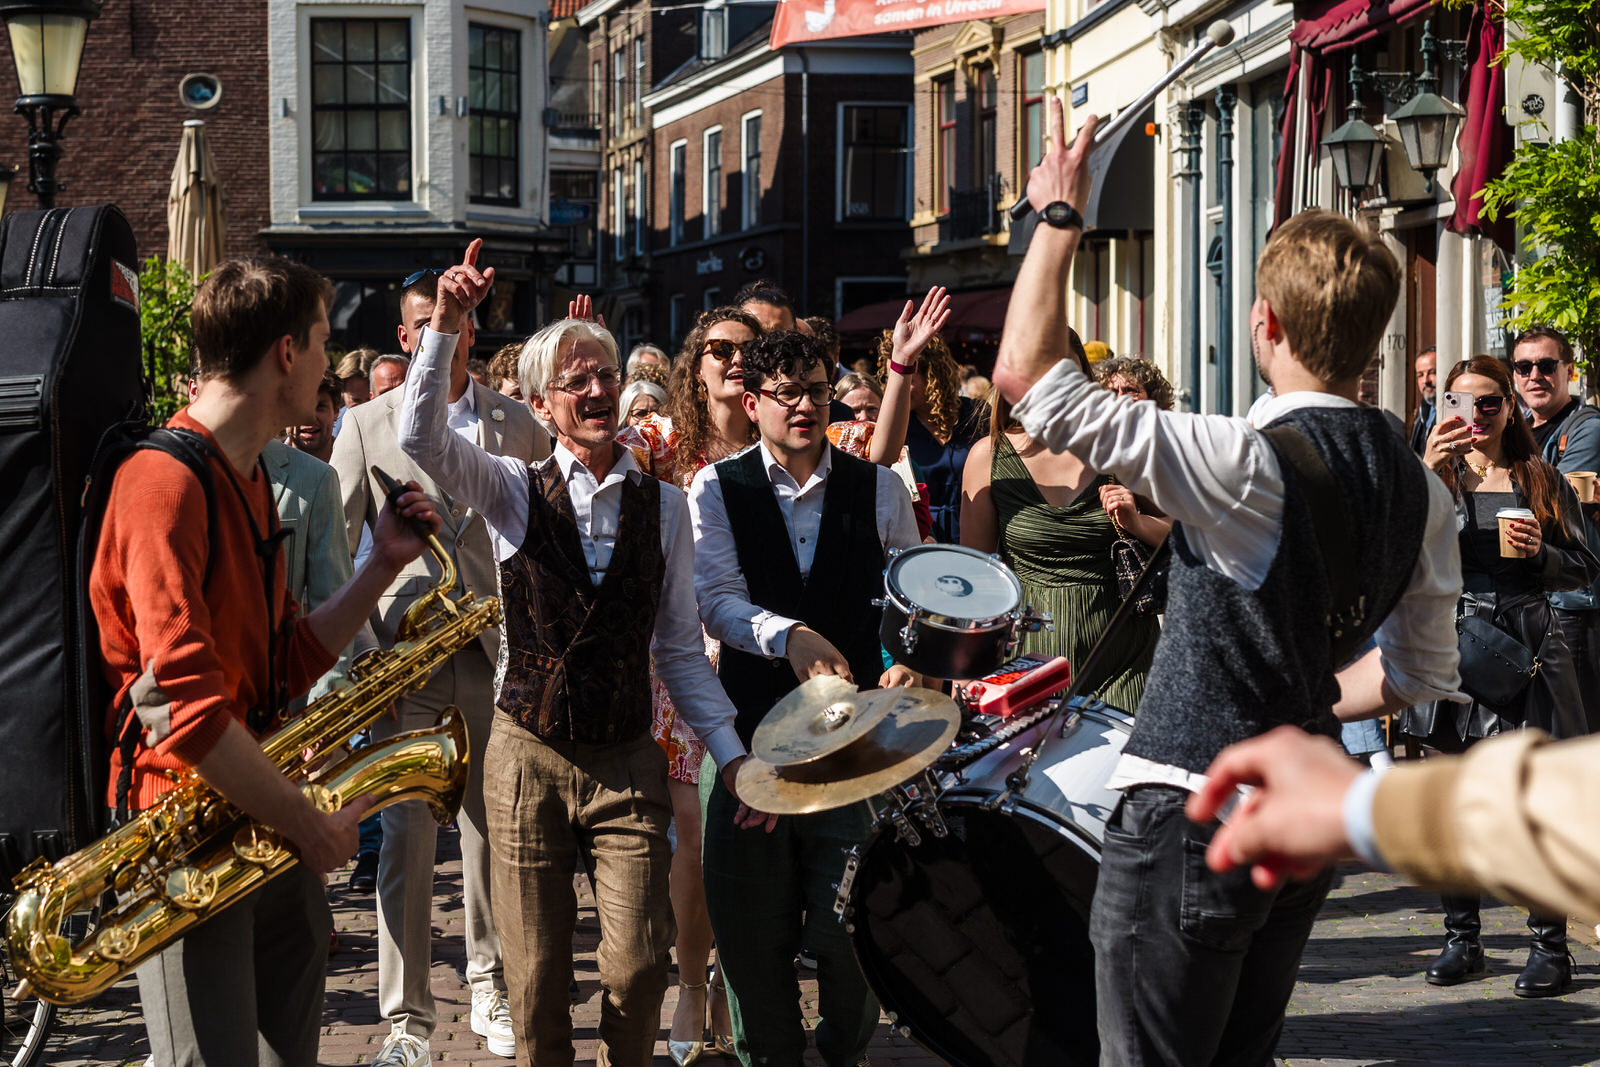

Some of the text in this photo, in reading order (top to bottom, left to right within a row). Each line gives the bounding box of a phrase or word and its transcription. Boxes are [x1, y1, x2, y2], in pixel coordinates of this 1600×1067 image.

[874, 9, 923, 25] samen
[926, 4, 942, 18] in
[1388, 333, 1406, 350] 170
